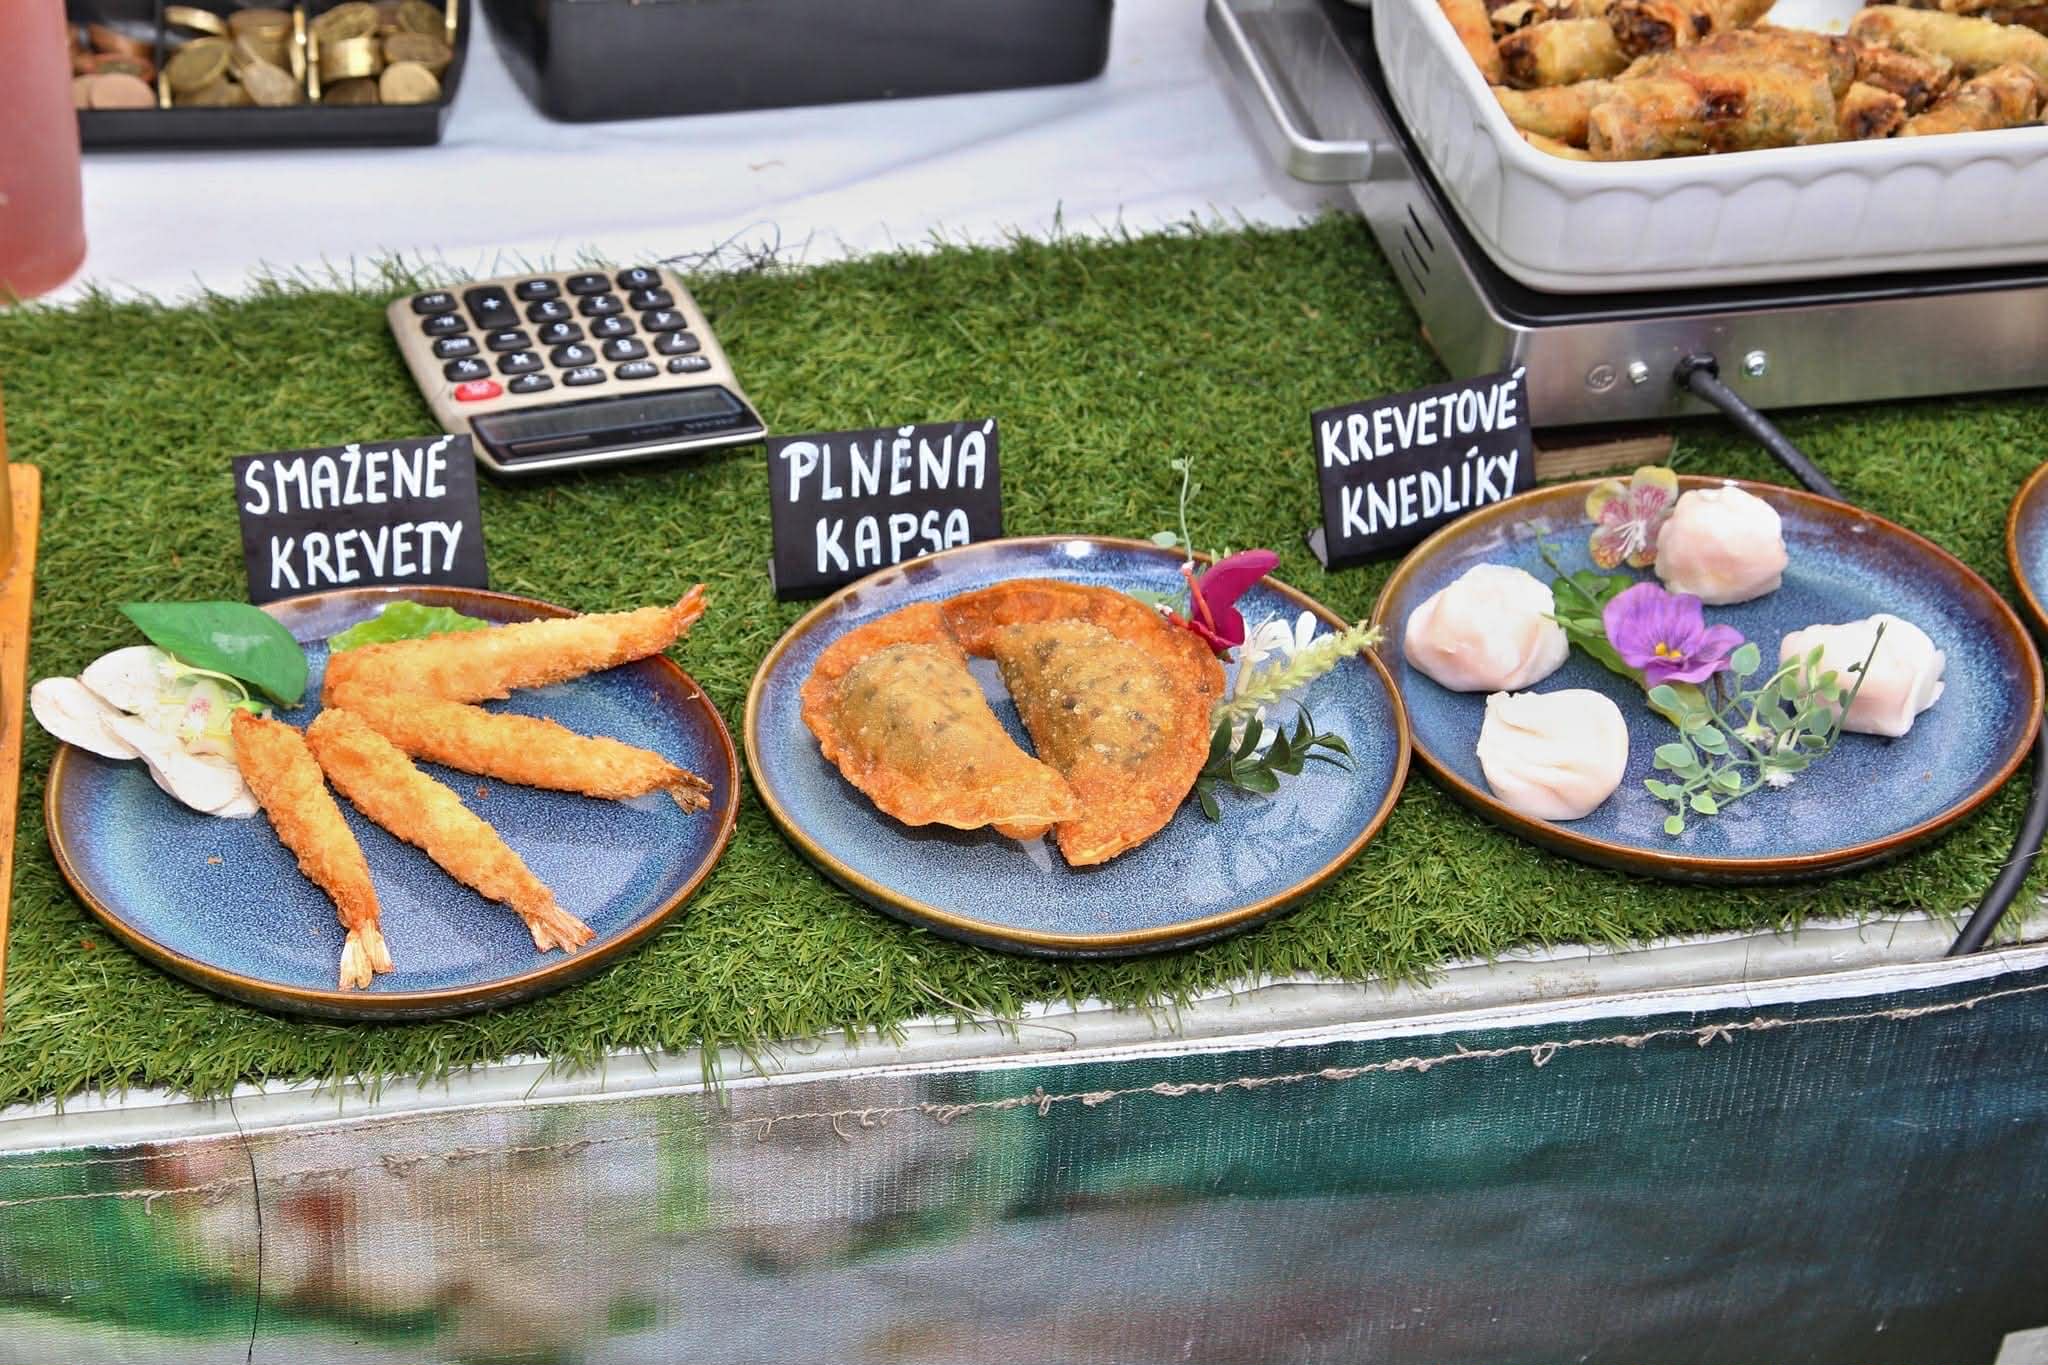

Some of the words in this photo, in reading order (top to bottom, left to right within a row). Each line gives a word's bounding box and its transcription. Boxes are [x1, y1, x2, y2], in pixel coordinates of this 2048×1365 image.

[632, 270, 647, 281] 0
[543, 302, 557, 315] 3
[593, 297, 608, 309] 2
[605, 318, 621, 331] 5
[658, 312, 671, 324] 4
[554, 324, 568, 338] 6
[618, 340, 632, 353] 8
[671, 333, 687, 347] 7
[567, 345, 582, 359] 9
[1320, 366, 1526, 468] KREVETOVÉ
[779, 418, 994, 503] PLNĚNÁ
[245, 434, 455, 515] SMAŽENÉ
[1341, 445, 1518, 538] KNEDLÍKY
[815, 508, 970, 574] KAPSA
[270, 520, 463, 589] KREVETY
